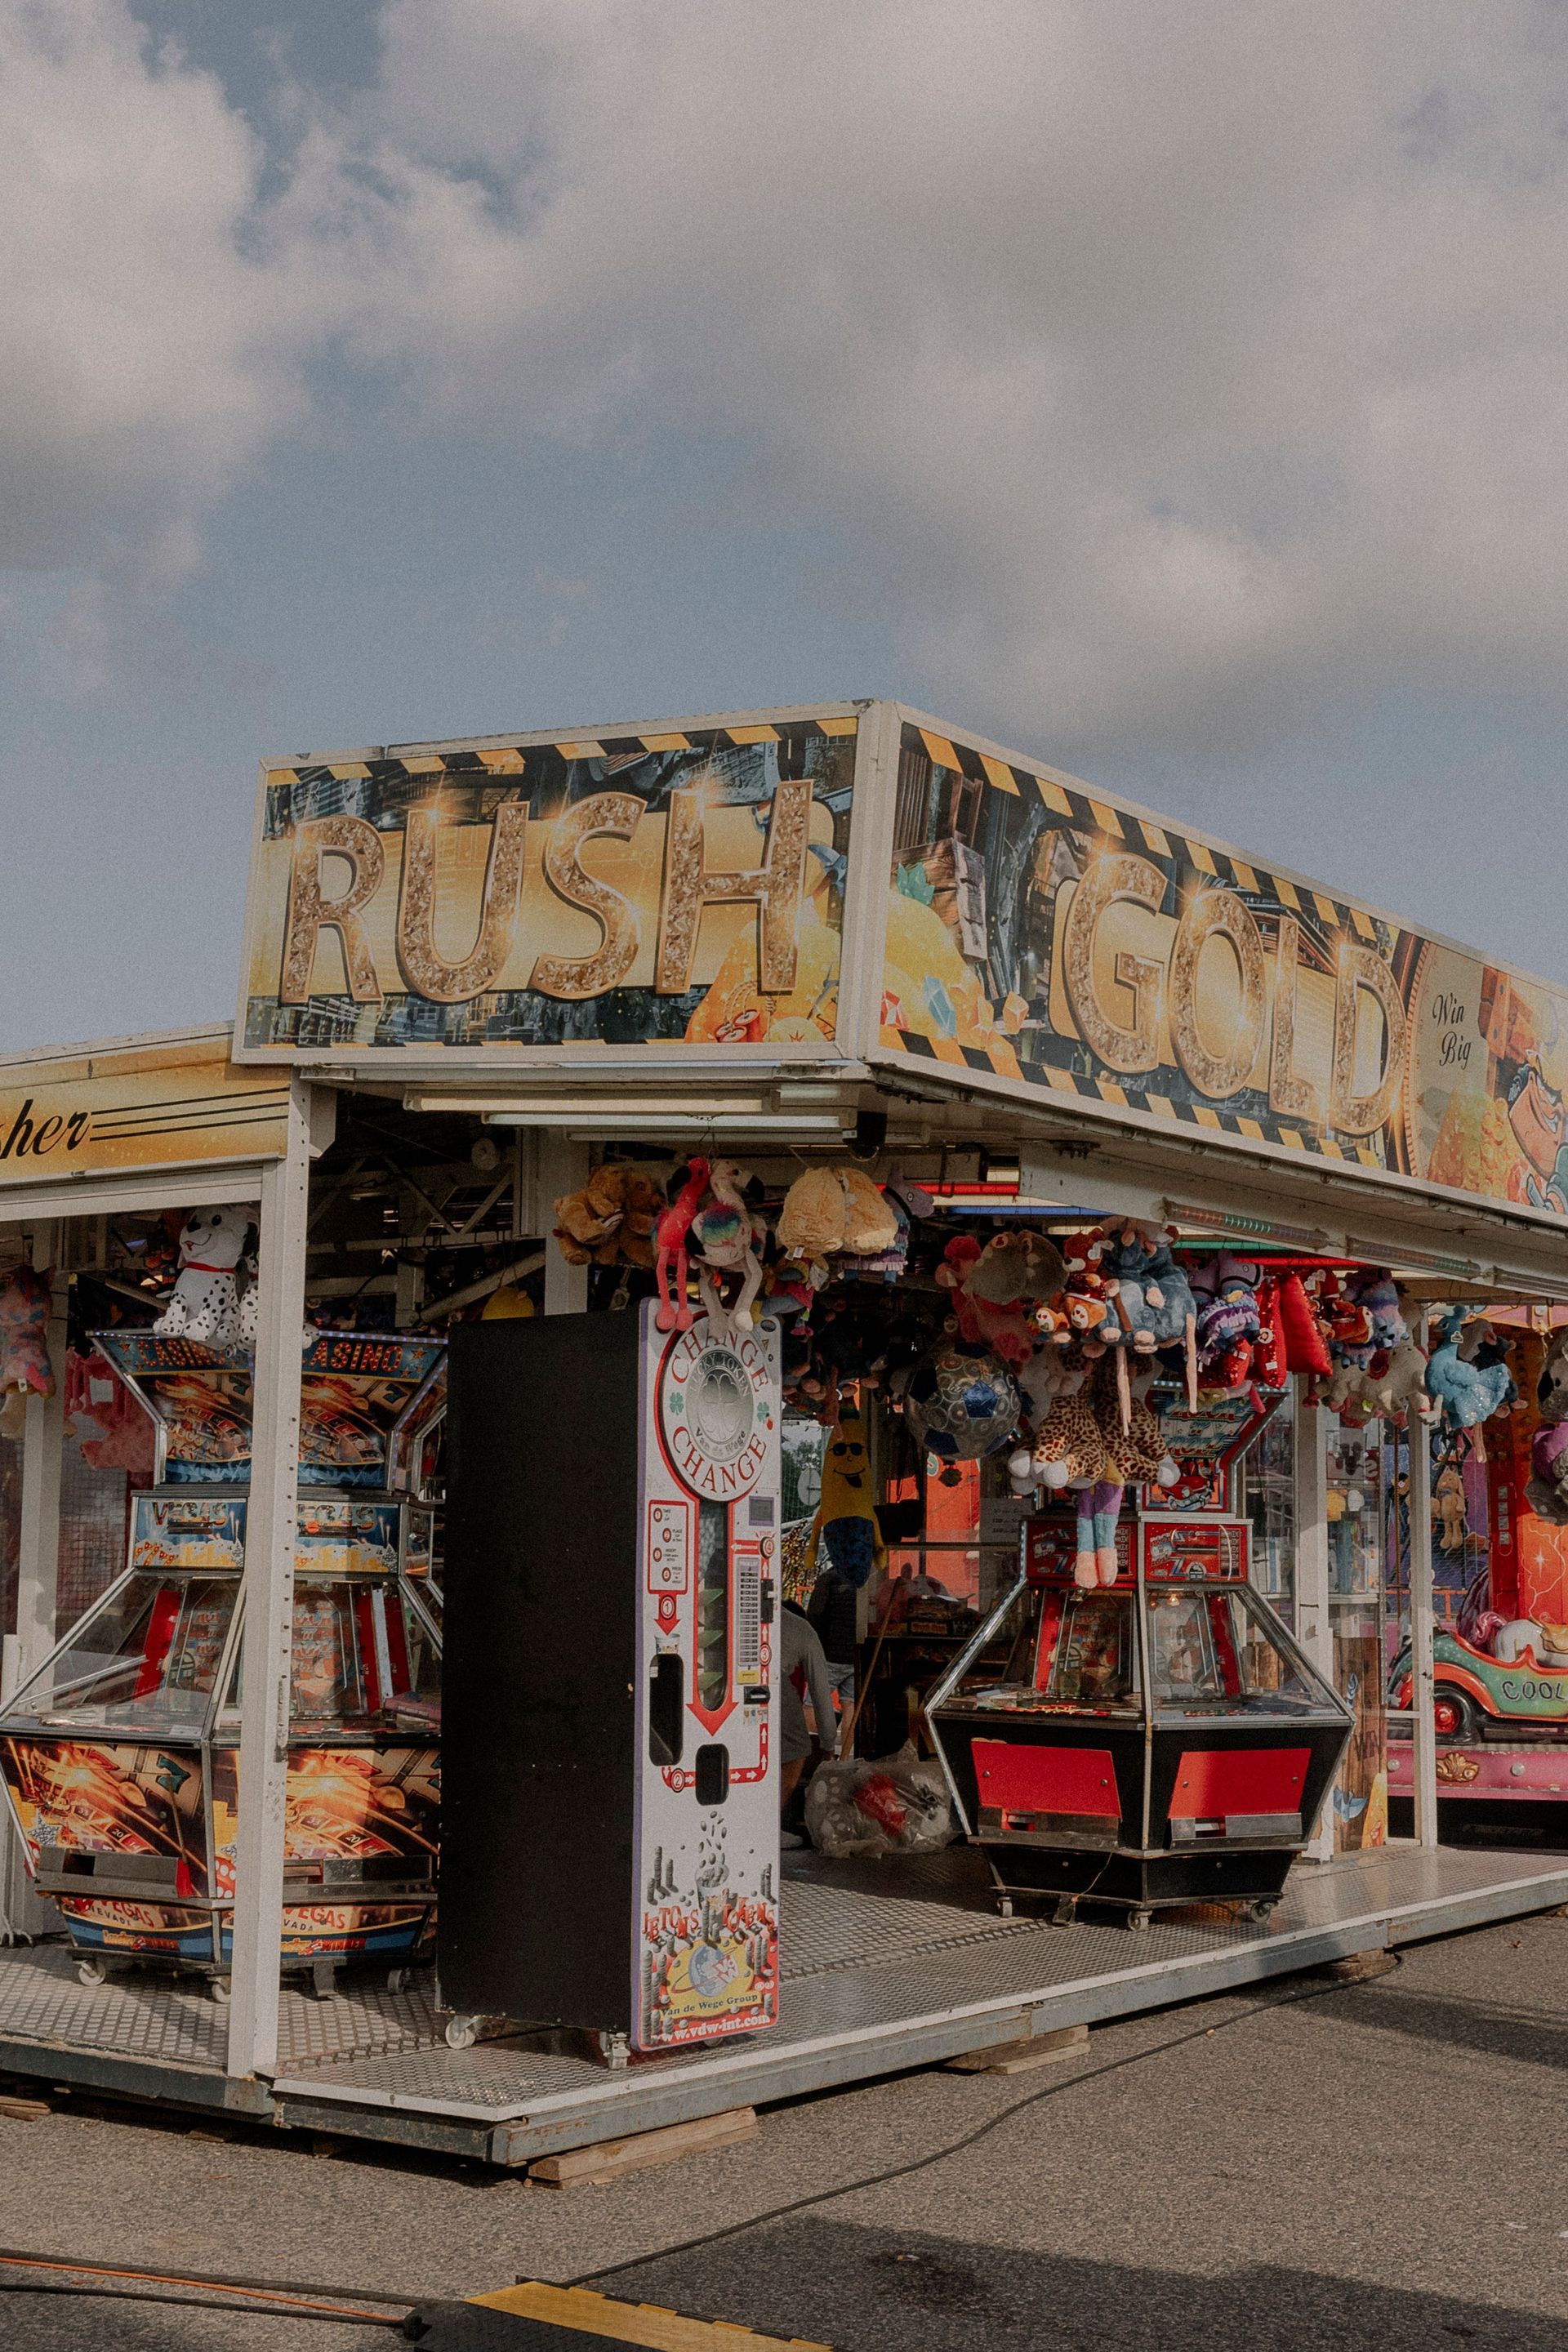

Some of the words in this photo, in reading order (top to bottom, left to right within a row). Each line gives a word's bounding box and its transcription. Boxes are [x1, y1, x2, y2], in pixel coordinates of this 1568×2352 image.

[280, 780, 814, 1004] RUSH
[1063, 851, 1408, 1138] GOLD
[1432, 993, 1465, 1026] Win
[1439, 1031, 1472, 1070] Big
[0, 1098, 90, 1160] her
[302, 1340, 403, 1372] ASINO
[671, 1328, 769, 1392] CHANGE
[720, 1356, 751, 1398] TOKEN
[672, 1425, 768, 1494] CHANGE
[297, 1503, 376, 1530] EGAS
[1501, 1680, 1568, 1702] COOL
[345, 1834, 361, 1843] 20
[642, 1905, 700, 1941] JETONS
[723, 1896, 775, 1932] TOKENS
[661, 2007, 680, 2016] Van
[683, 2004, 695, 2013] de
[698, 2000, 724, 2010] Wege
[726, 1993, 759, 2006] Group
